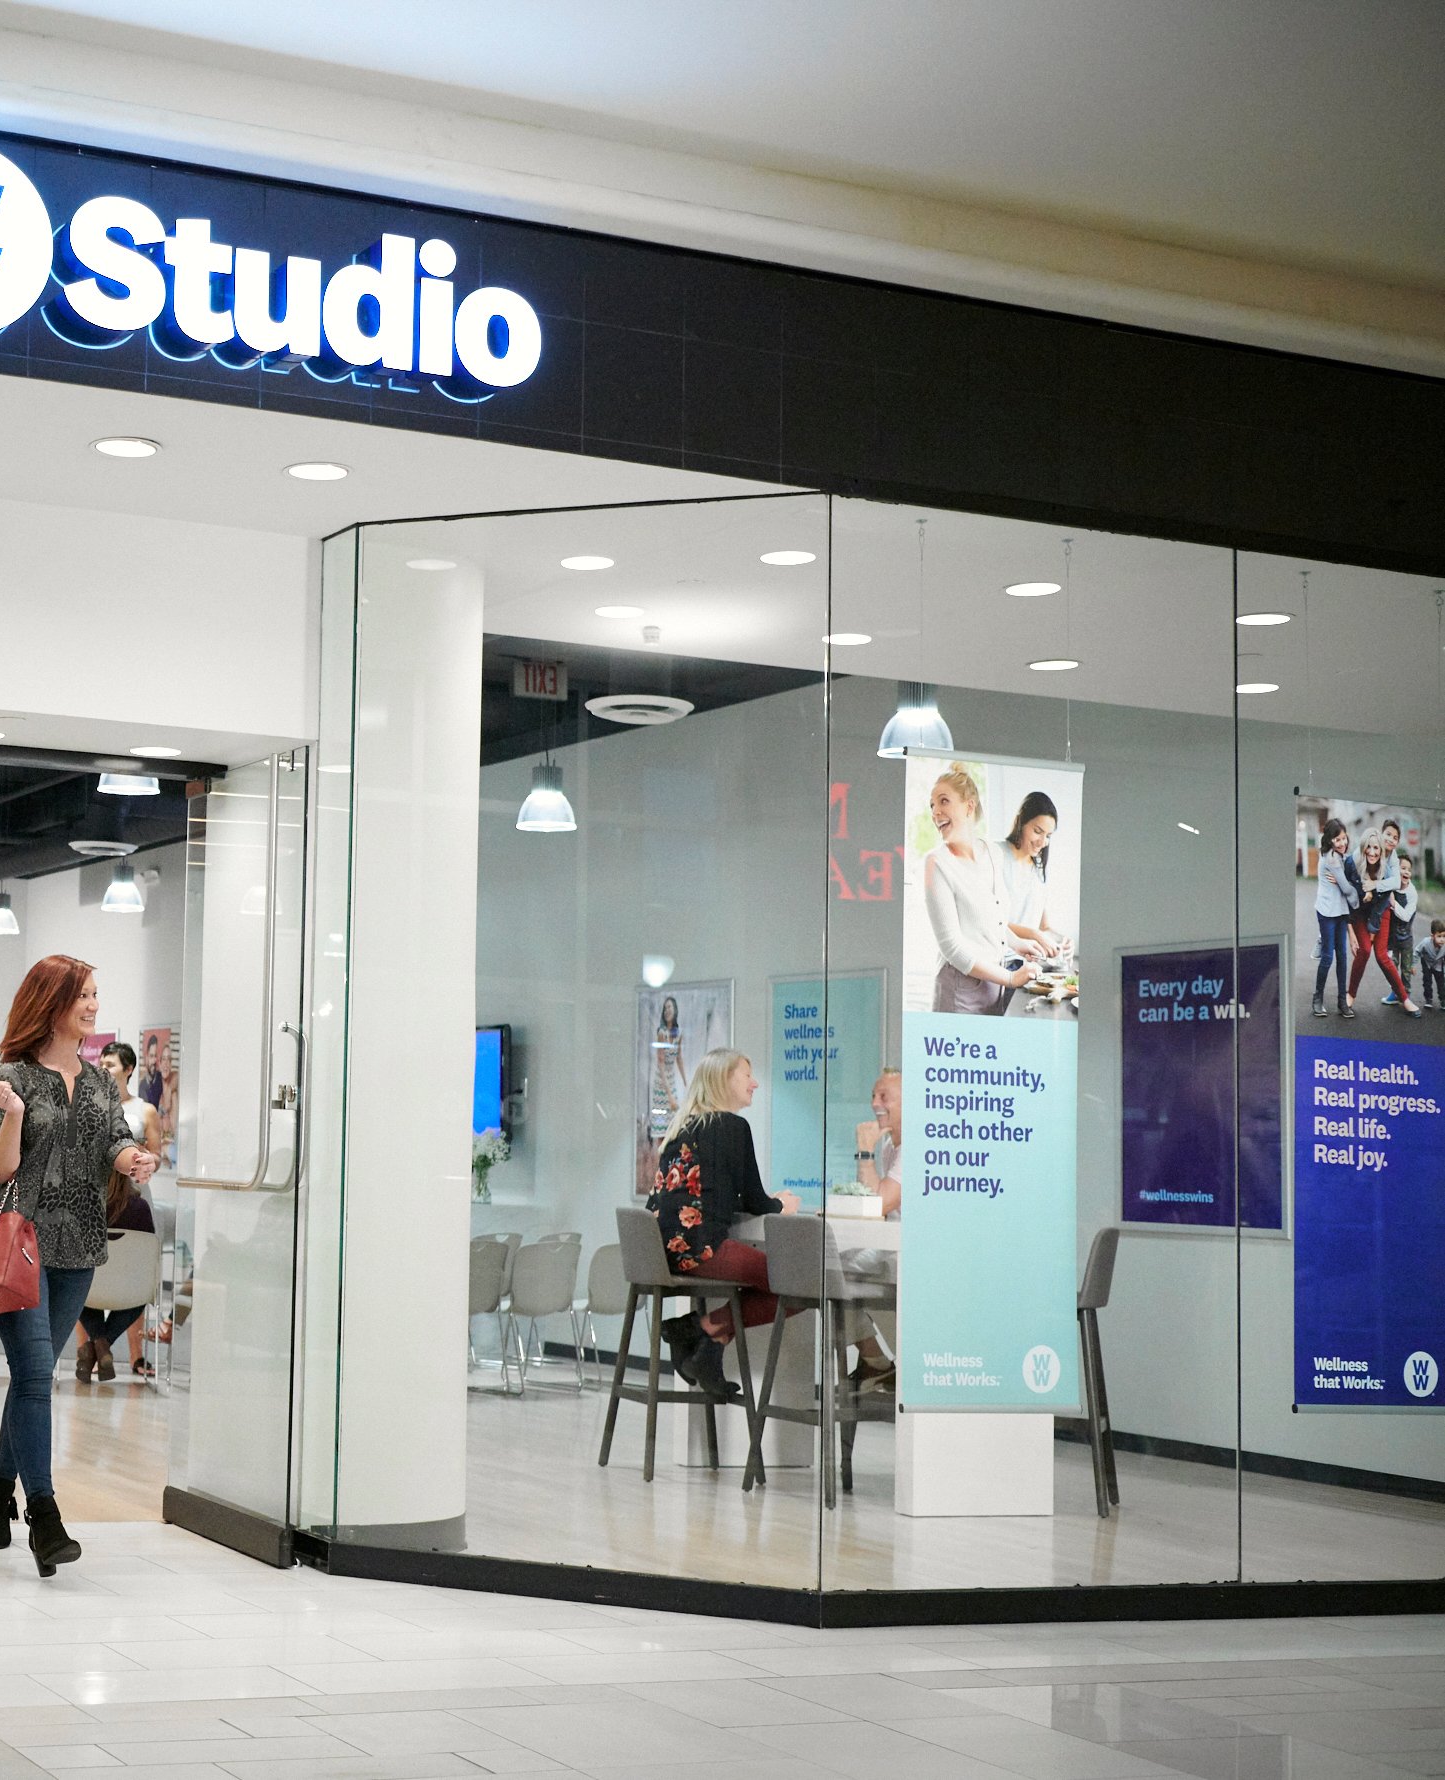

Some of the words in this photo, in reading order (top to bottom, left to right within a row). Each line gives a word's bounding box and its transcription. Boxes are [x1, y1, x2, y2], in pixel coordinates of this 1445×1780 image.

[63, 195, 542, 388] Studio
[1139, 979, 1187, 1000] Every
[1191, 975, 1224, 998] day
[784, 1004, 818, 1019] Share
[1139, 1007, 1168, 1022] can
[1173, 1002, 1194, 1020] be
[1199, 1005, 1209, 1019] a
[784, 1024, 835, 1039] wellnes
[784, 1045, 808, 1060] with
[924, 1036, 981, 1058] We’re
[985, 1044, 997, 1060] a
[784, 1065, 818, 1080] world.
[925, 1066, 1045, 1093] community,
[1314, 1059, 1355, 1080] Real
[1359, 1062, 1419, 1085] health.
[925, 1088, 1015, 1118] inspiring
[1314, 1087, 1355, 1107] Real
[1359, 1093, 1441, 1116] progress.
[924, 1119, 973, 1140] each
[978, 1121, 1033, 1142] other
[1314, 1116, 1355, 1138] Real
[1359, 1118, 1391, 1140] life.
[924, 1149, 951, 1165] on
[955, 1150, 989, 1167] our
[1314, 1144, 1355, 1166] Real
[1357, 1146, 1388, 1171] joy.
[922, 1169, 1004, 1198] journey.
[1139, 1188, 1214, 1203] #wellnesswins
[923, 1353, 983, 1368] Wellness
[1313, 1357, 1368, 1372] Wellness
[923, 1371, 953, 1387] that
[1313, 1374, 1341, 1389] that
